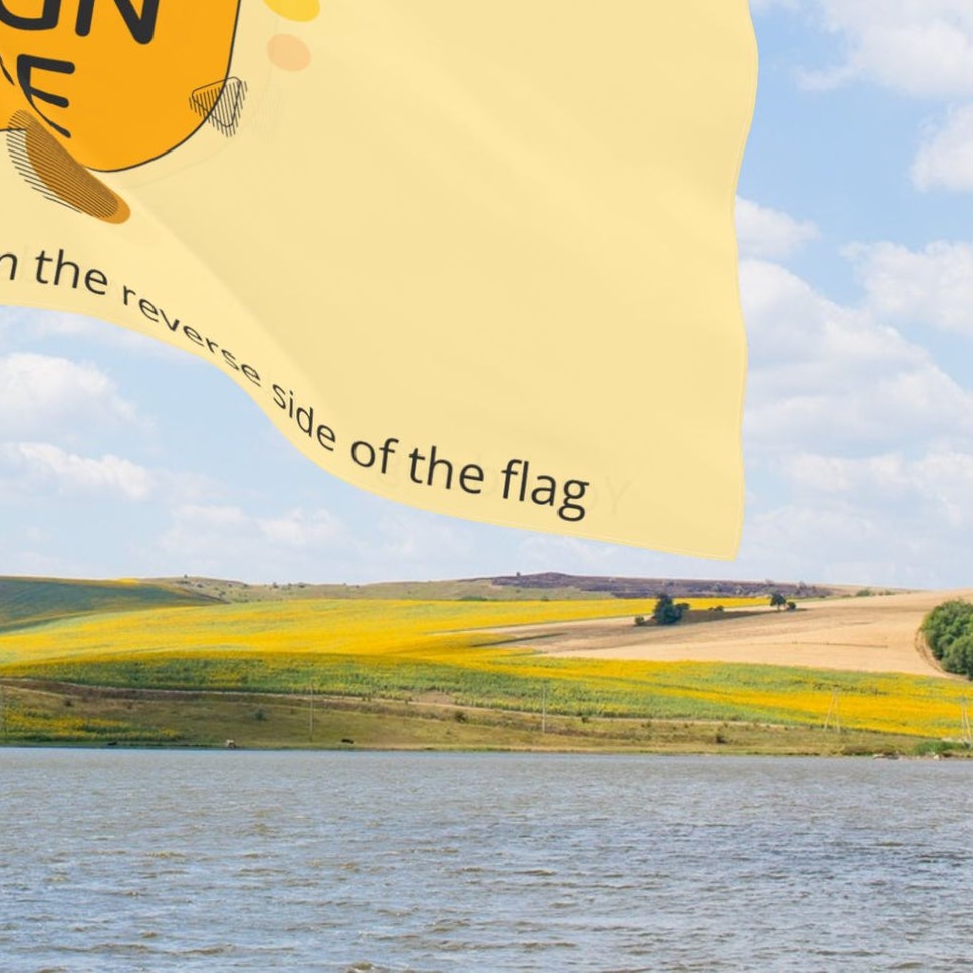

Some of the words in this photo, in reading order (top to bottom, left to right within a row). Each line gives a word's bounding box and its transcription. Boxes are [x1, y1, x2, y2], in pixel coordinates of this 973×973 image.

[35, 248, 109, 296] the
[122, 283, 262, 388] reverse
[271, 381, 337, 453] side
[350, 437, 400, 474] of
[408, 445, 486, 495] the
[501, 458, 591, 523] flag
